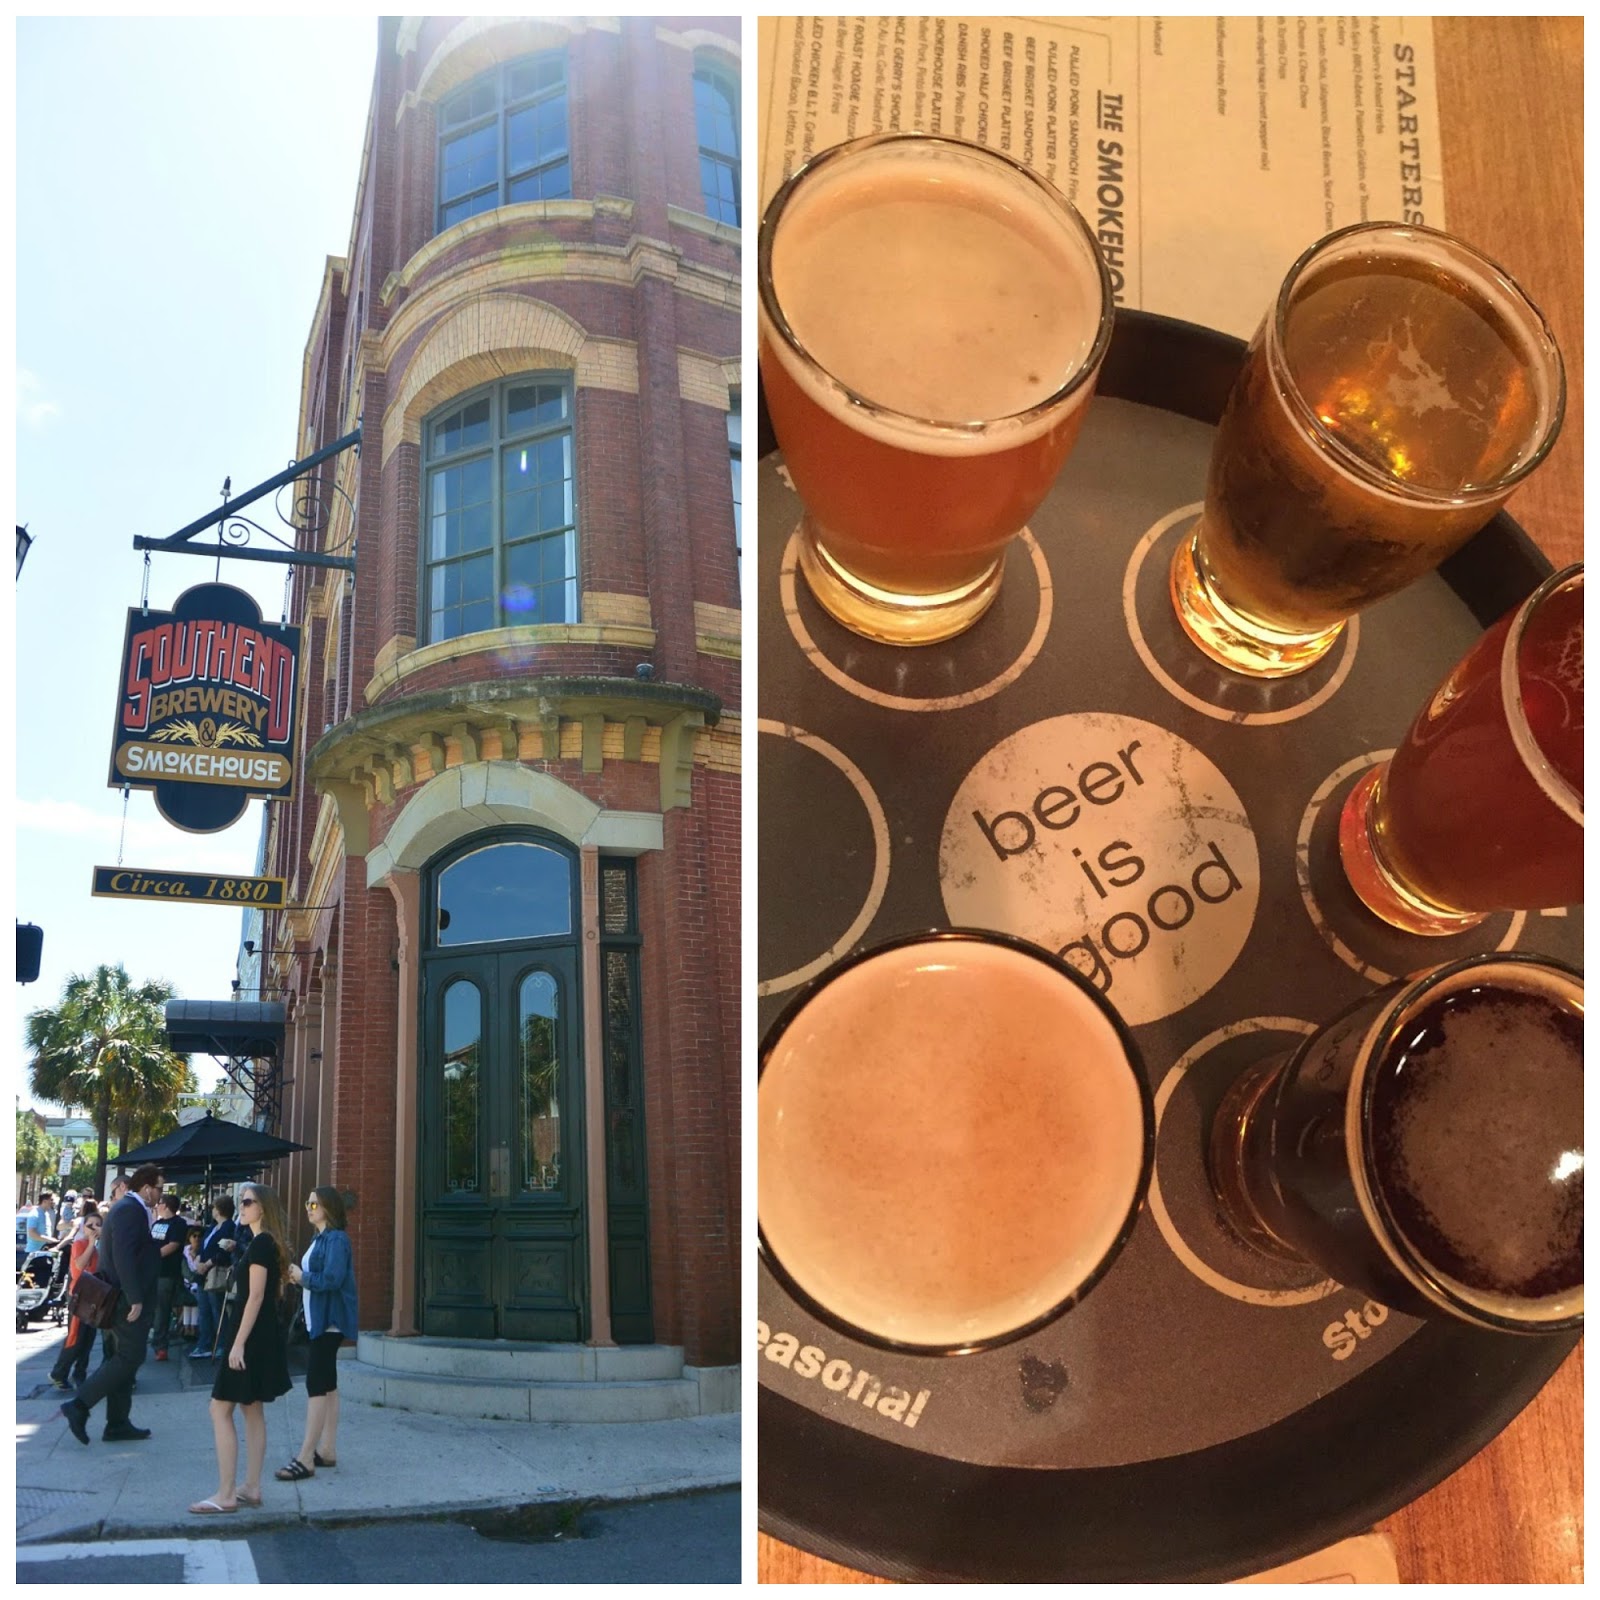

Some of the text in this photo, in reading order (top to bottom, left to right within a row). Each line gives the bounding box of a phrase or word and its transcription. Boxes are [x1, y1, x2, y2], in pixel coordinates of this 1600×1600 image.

[853, 24, 865, 59] ROAST
[932, 17, 946, 89] SMOKEHOUSE
[957, 23, 968, 61] DANISH
[979, 27, 991, 70] SMOKED
[1047, 41, 1059, 83] PULLED
[808, 40, 822, 89] CHICKEN
[849, 61, 862, 102] HOAGIE
[956, 63, 967, 88] RIBS
[1069, 45, 1081, 87] PULLED
[955, 90, 966, 115] Pinto
[978, 72, 990, 101] HALF
[1000, 31, 1014, 151] BEEF BRISKET PLATTER
[1023, 36, 1036, 166] BEEF BRISKET SANDWICH
[1047, 84, 1058, 113] PORK
[1068, 88, 1080, 117] PORK
[1217, 87, 1228, 116] Butter
[1046, 115, 1057, 160] PLATTER
[1068, 119, 1080, 175] SANDWICH
[1394, 43, 1425, 225] STARTERS
[1097, 92, 1124, 307] THE SMOKEHO
[123, 619, 295, 744] SOUTHEND
[149, 686, 268, 731] BREWERY
[202, 722, 217, 745] &
[125, 745, 282, 783] SMOKEHOUSE
[972, 739, 1144, 862] beer
[109, 872, 269, 902] Circa. 1880
[1071, 841, 1146, 899] is
[1056, 841, 1243, 996] good
